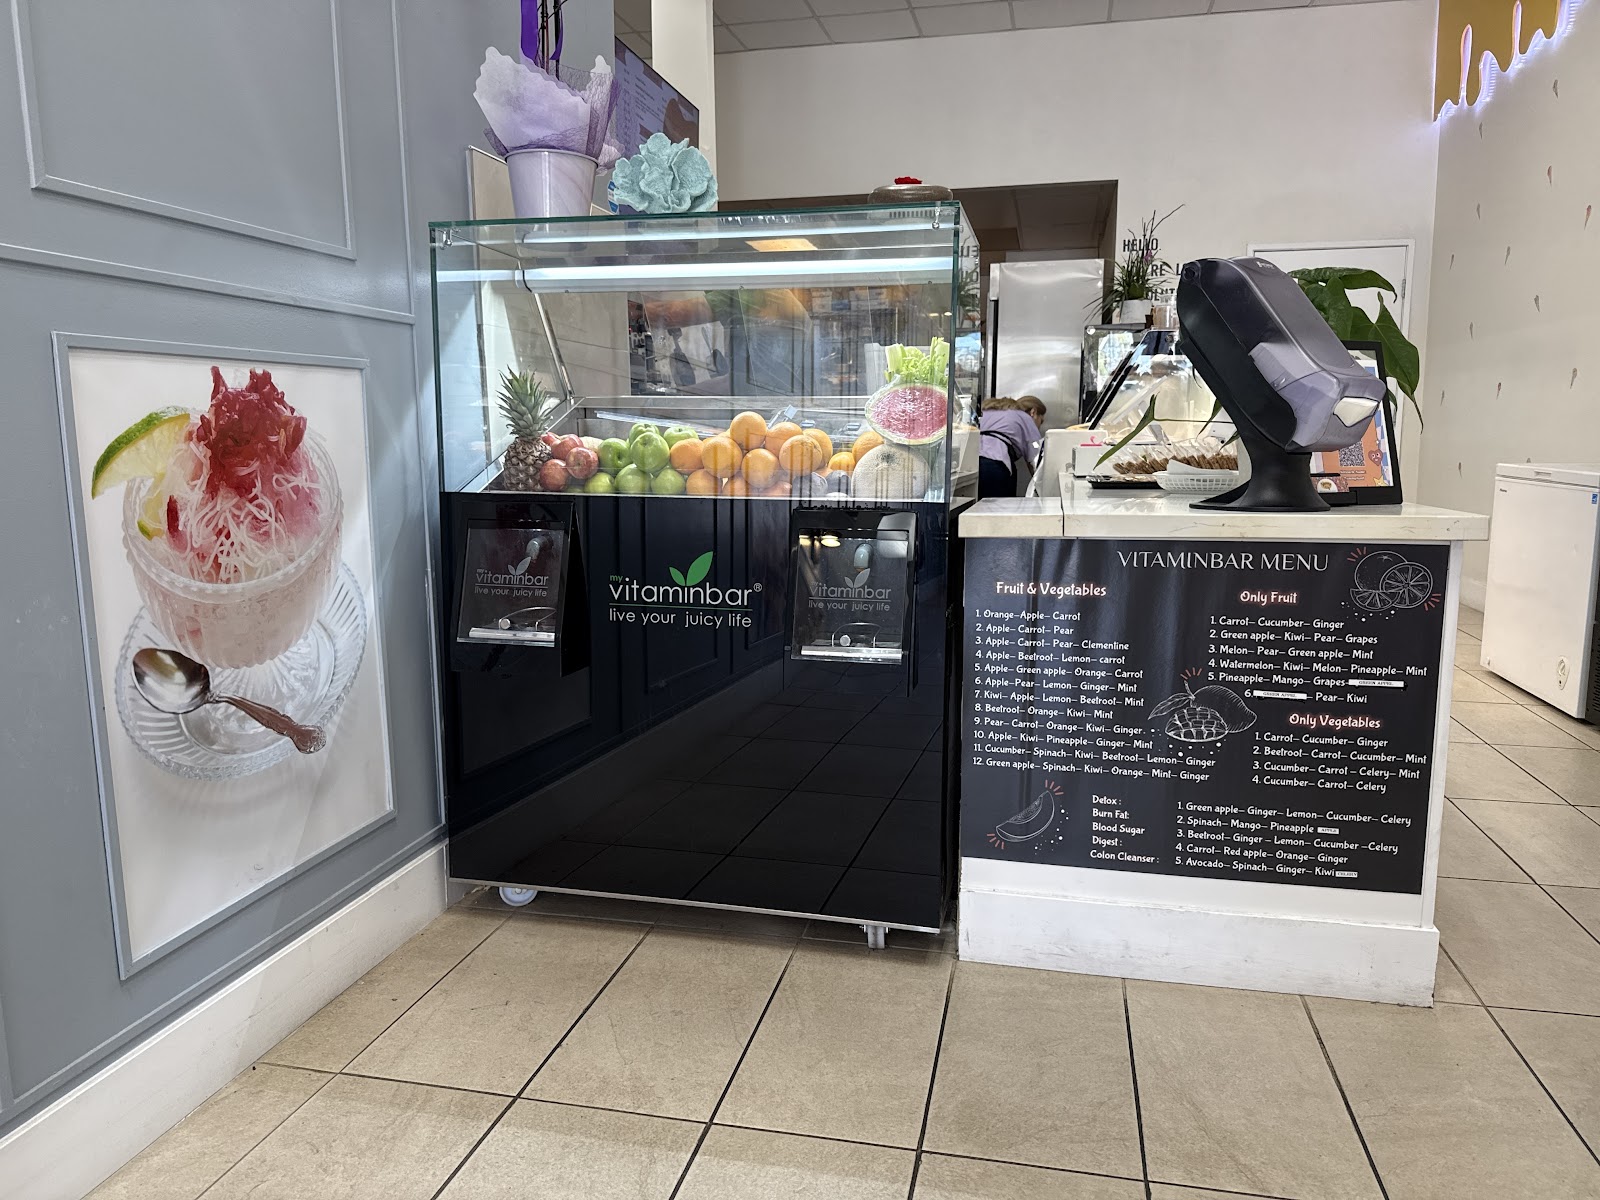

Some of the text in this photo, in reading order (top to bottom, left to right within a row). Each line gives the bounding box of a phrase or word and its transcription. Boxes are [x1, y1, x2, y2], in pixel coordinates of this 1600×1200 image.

[1117, 551, 1328, 571] VITAMINBAR MENU
[476, 570, 549, 585] vitaminbar
[609, 574, 624, 583] my
[475, 586, 547, 598] live your juicy life
[809, 582, 892, 599] vitaminbar
[996, 581, 1106, 599] Fruit & Vegetables
[1240, 591, 1297, 606] Only Fruit
[808, 600, 891, 612] live your juicy life
[609, 608, 752, 629] live your juicy life
[1052, 611, 1080, 621] Carrot
[1054, 625, 1074, 634] Pear
[1313, 619, 1344, 631] Ginger
[1220, 630, 1247, 639] Green
[1345, 634, 1377, 645] Grapes
[1081, 640, 1129, 650] Clementine
[1288, 647, 1315, 657] Green
[1352, 650, 1373, 659] Mint
[1099, 656, 1125, 664] carrot
[1016, 665, 1041, 674] Green
[1115, 669, 1143, 678] Carrot
[1406, 666, 1427, 676] Mint
[1117, 683, 1137, 692] Mint
[1124, 697, 1144, 706] Mint
[1347, 693, 1367, 703] Kiwi
[1094, 710, 1113, 719] Mint
[1289, 713, 1380, 730] Only Vegetables
[1133, 740, 1153, 749] Mint
[1357, 737, 1388, 749] Ginger
[1186, 756, 1216, 769] Ginger
[1405, 754, 1427, 764] Mint
[986, 758, 1010, 767] Green
[1180, 771, 1209, 783] Ginger
[1318, 765, 1348, 775] Carrot
[1399, 769, 1420, 779] Mint
[1356, 781, 1386, 794] Celery
[1092, 795, 1117, 805] Detox
[1093, 808, 1112, 818] Burn
[1186, 802, 1212, 812] Green
[1381, 814, 1411, 827] Celery
[1092, 822, 1145, 836] Blood Sugar
[1270, 822, 1314, 834] Pineapple
[1092, 835, 1118, 847] Digest
[1233, 833, 1263, 845] Ginger
[1313, 838, 1359, 849] Cucumber
[1090, 850, 1155, 863] Colon Cleanser
[1224, 846, 1241, 856] Red
[1317, 853, 1348, 865] Ginger
[1315, 866, 1335, 877] Kiwi
